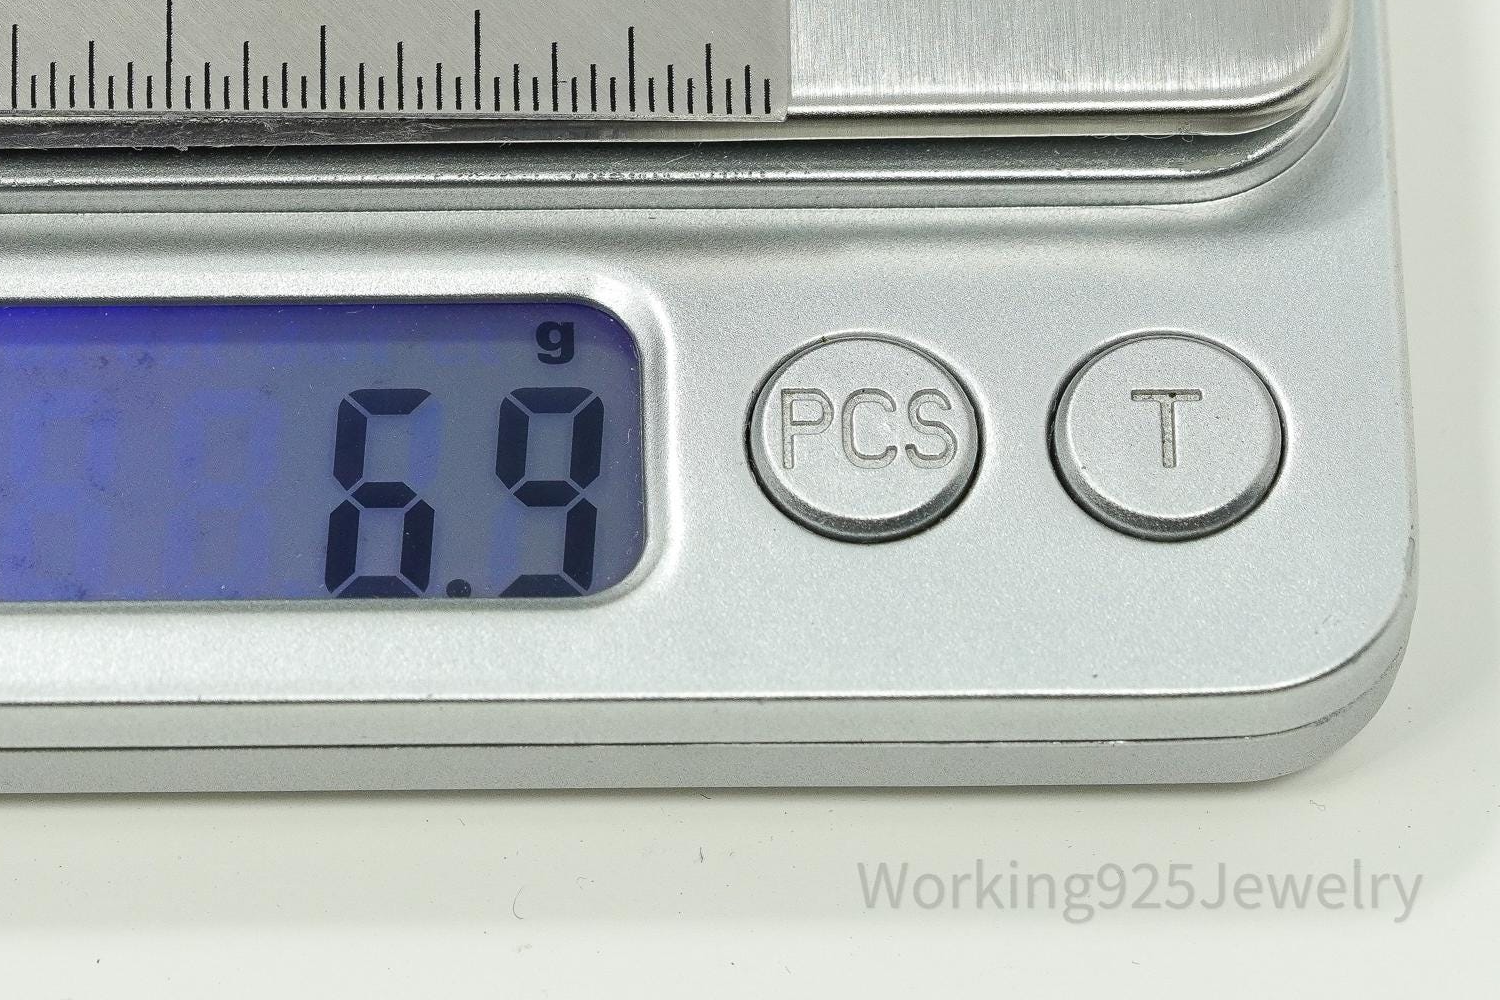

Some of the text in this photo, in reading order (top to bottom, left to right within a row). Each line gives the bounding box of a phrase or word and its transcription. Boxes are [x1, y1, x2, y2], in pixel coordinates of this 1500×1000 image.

[535, 320, 575, 365] g
[780, 387, 959, 470] PCS
[1130, 388, 1204, 469] T
[324, 386, 605, 598] 6.9
